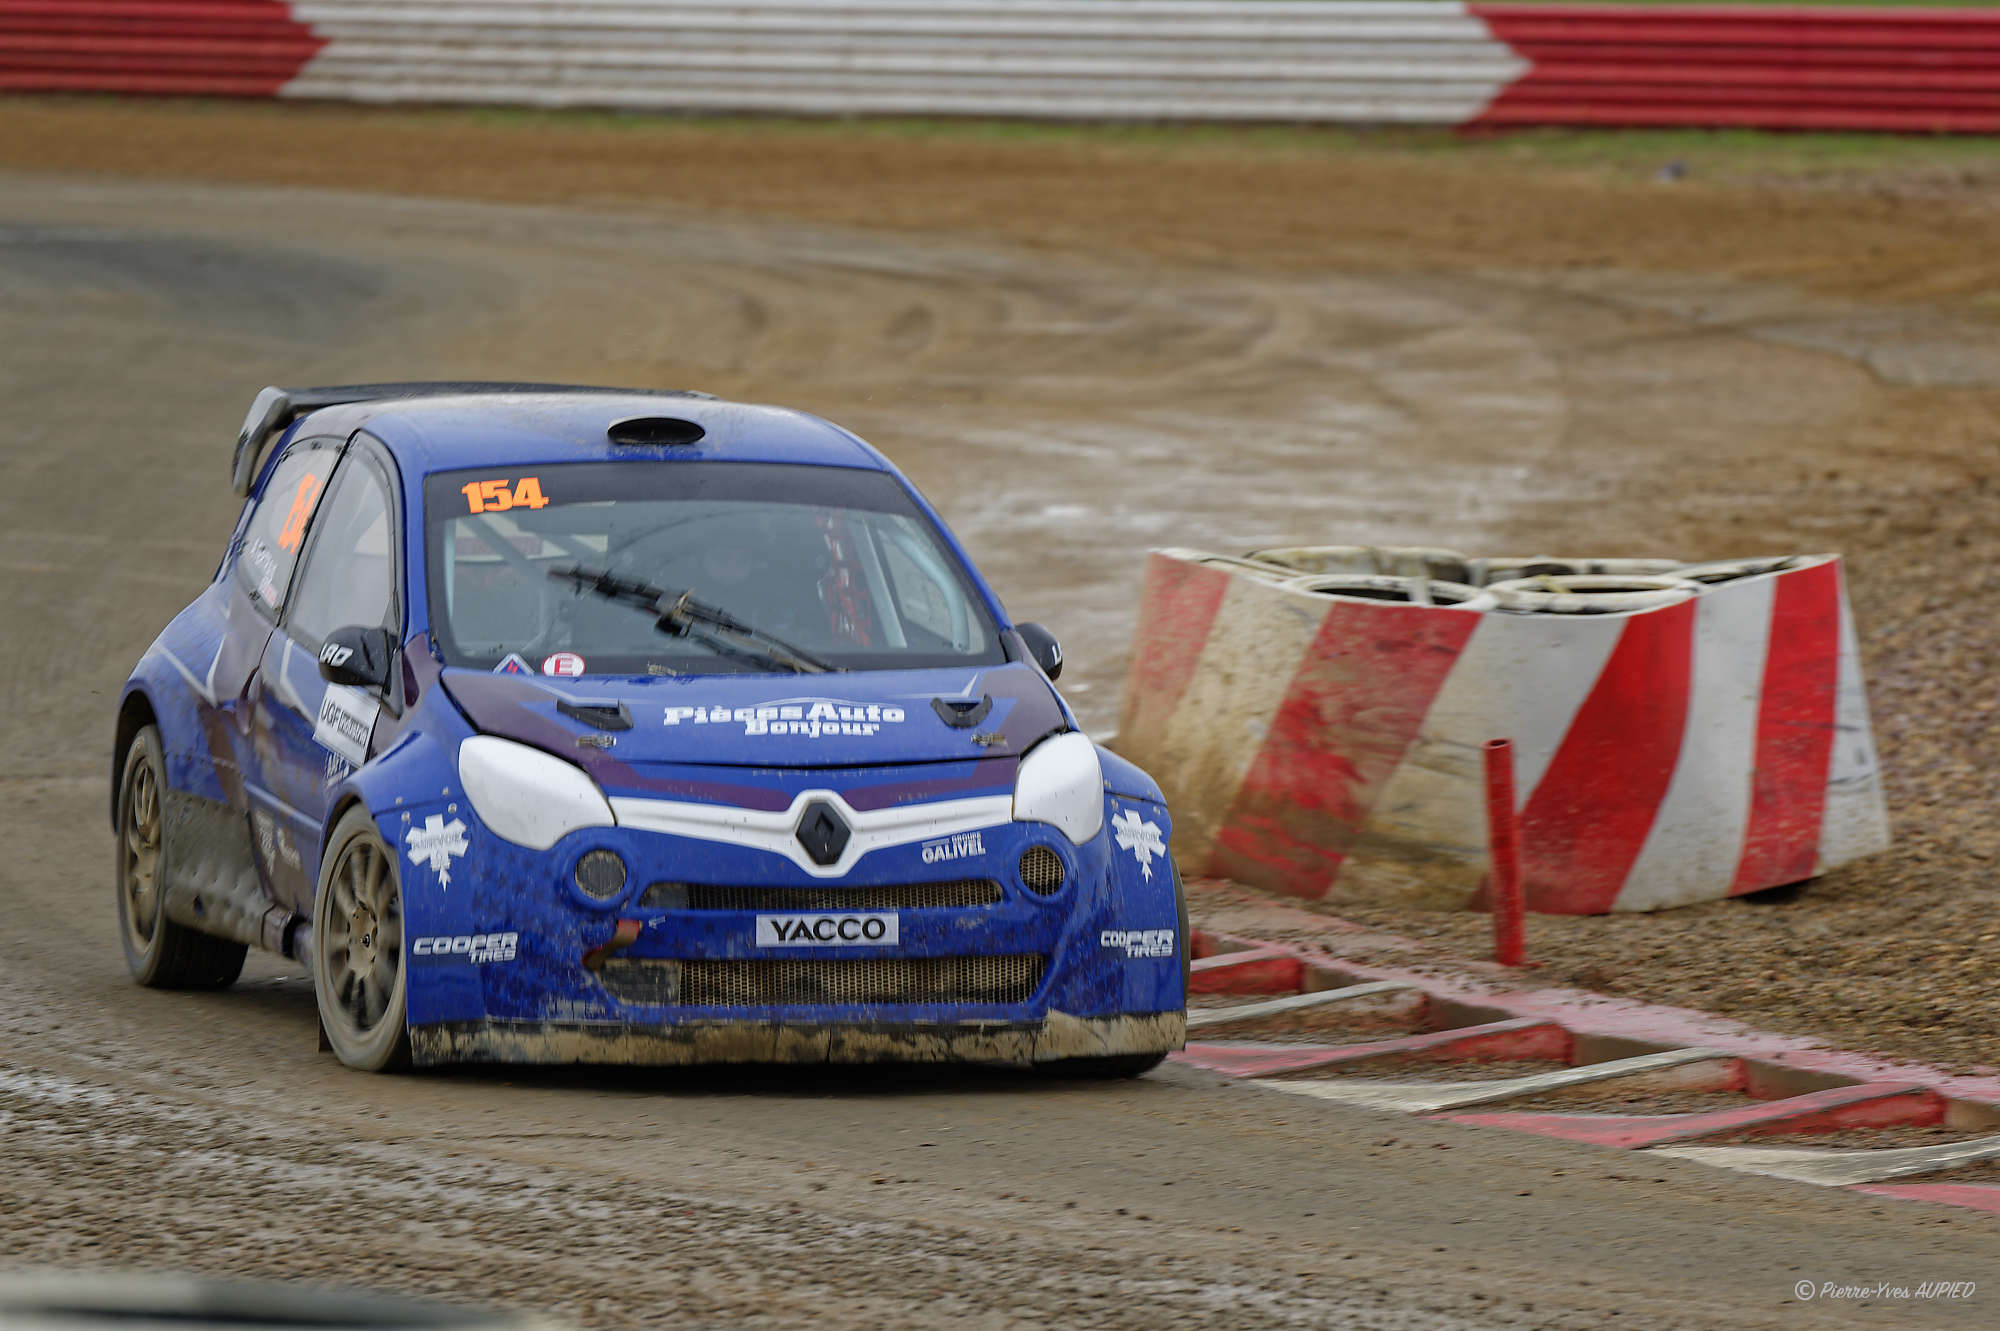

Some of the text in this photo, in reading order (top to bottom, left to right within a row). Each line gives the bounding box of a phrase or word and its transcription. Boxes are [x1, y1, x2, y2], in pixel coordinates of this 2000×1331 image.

[461, 477, 550, 514] 154
[663, 702, 905, 726] Pièces Auto
[744, 719, 880, 739] Bonjour
[770, 918, 886, 941] YACCO
[1100, 929, 1174, 948] COOPER
[413, 932, 518, 955] COOPER
[1126, 945, 1174, 959] TIRES
[468, 949, 516, 964] TIRES
